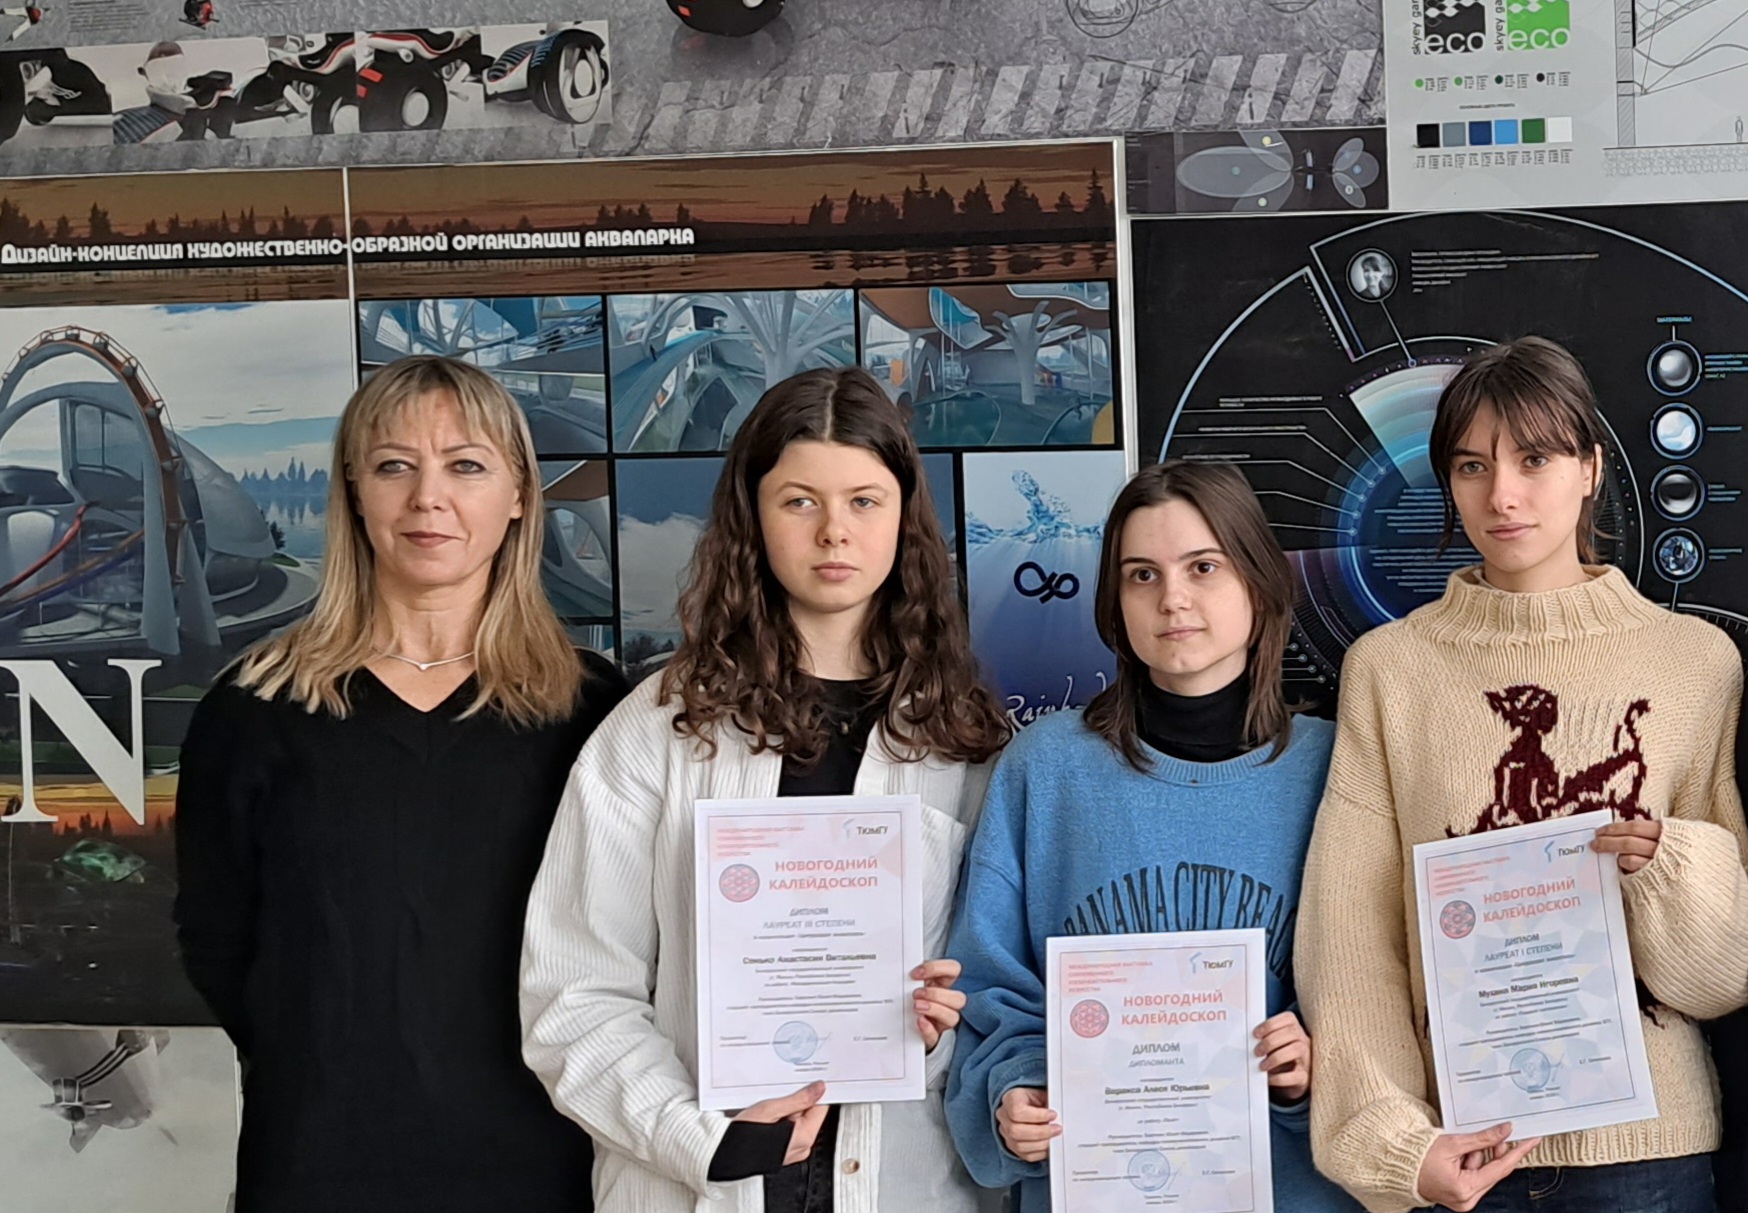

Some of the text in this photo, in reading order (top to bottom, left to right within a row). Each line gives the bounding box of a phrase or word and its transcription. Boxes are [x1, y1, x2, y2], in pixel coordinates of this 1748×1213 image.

[1425, 32, 1486, 54] eco
[1508, 27, 1571, 51] eco
[775, 856, 878, 873] НОВОГОДНИЙ
[769, 874, 878, 891] КАЛЕЙДОСКОП
[1484, 875, 1576, 904] НОВОГОДНИЙ
[1483, 896, 1581, 923] КАЛЕЙДОСКОП
[1504, 933, 1540, 947] ДИПЛОМ
[1123, 989, 1223, 1007] НОВОГОДНИЙ
[1122, 1009, 1227, 1026] КАЛЕЙДОСКОП
[1132, 1043, 1180, 1055] ДИПЛОМ
